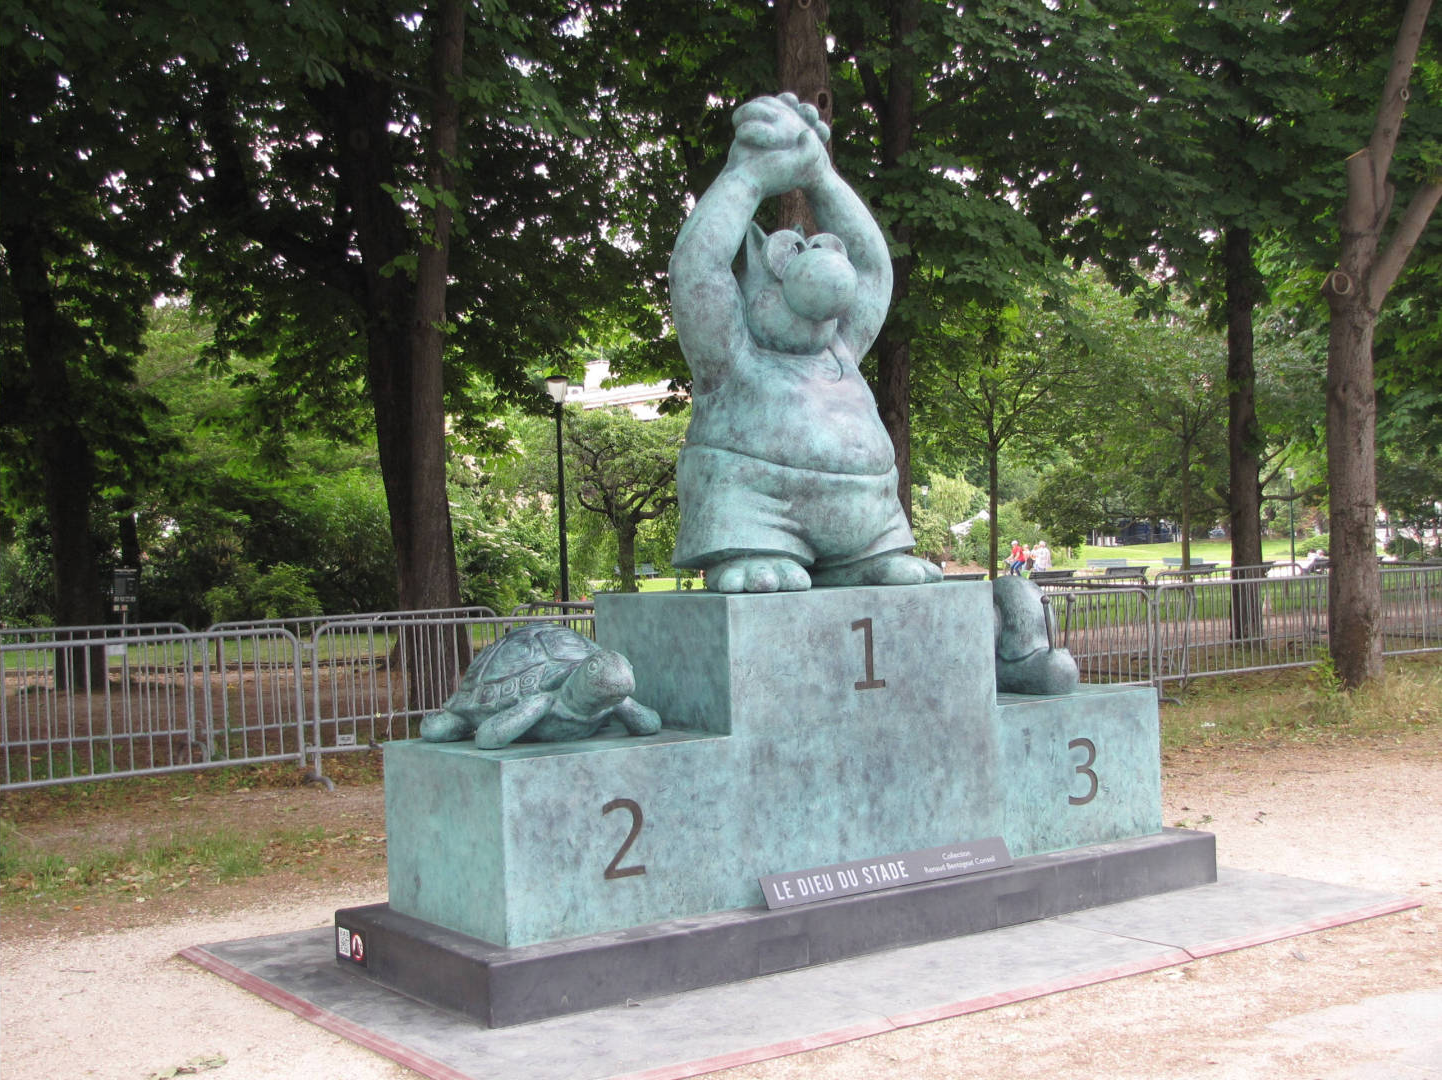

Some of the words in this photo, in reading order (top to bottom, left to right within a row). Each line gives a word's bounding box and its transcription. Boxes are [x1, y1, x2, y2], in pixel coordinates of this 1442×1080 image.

[851, 618, 887, 691] 1
[1067, 737, 1099, 806] 3
[602, 799, 646, 880] 2
[772, 880, 794, 901] LE
[797, 873, 834, 896] DIEU
[836, 869, 859, 889] DU
[861, 860, 909, 884] STADE
